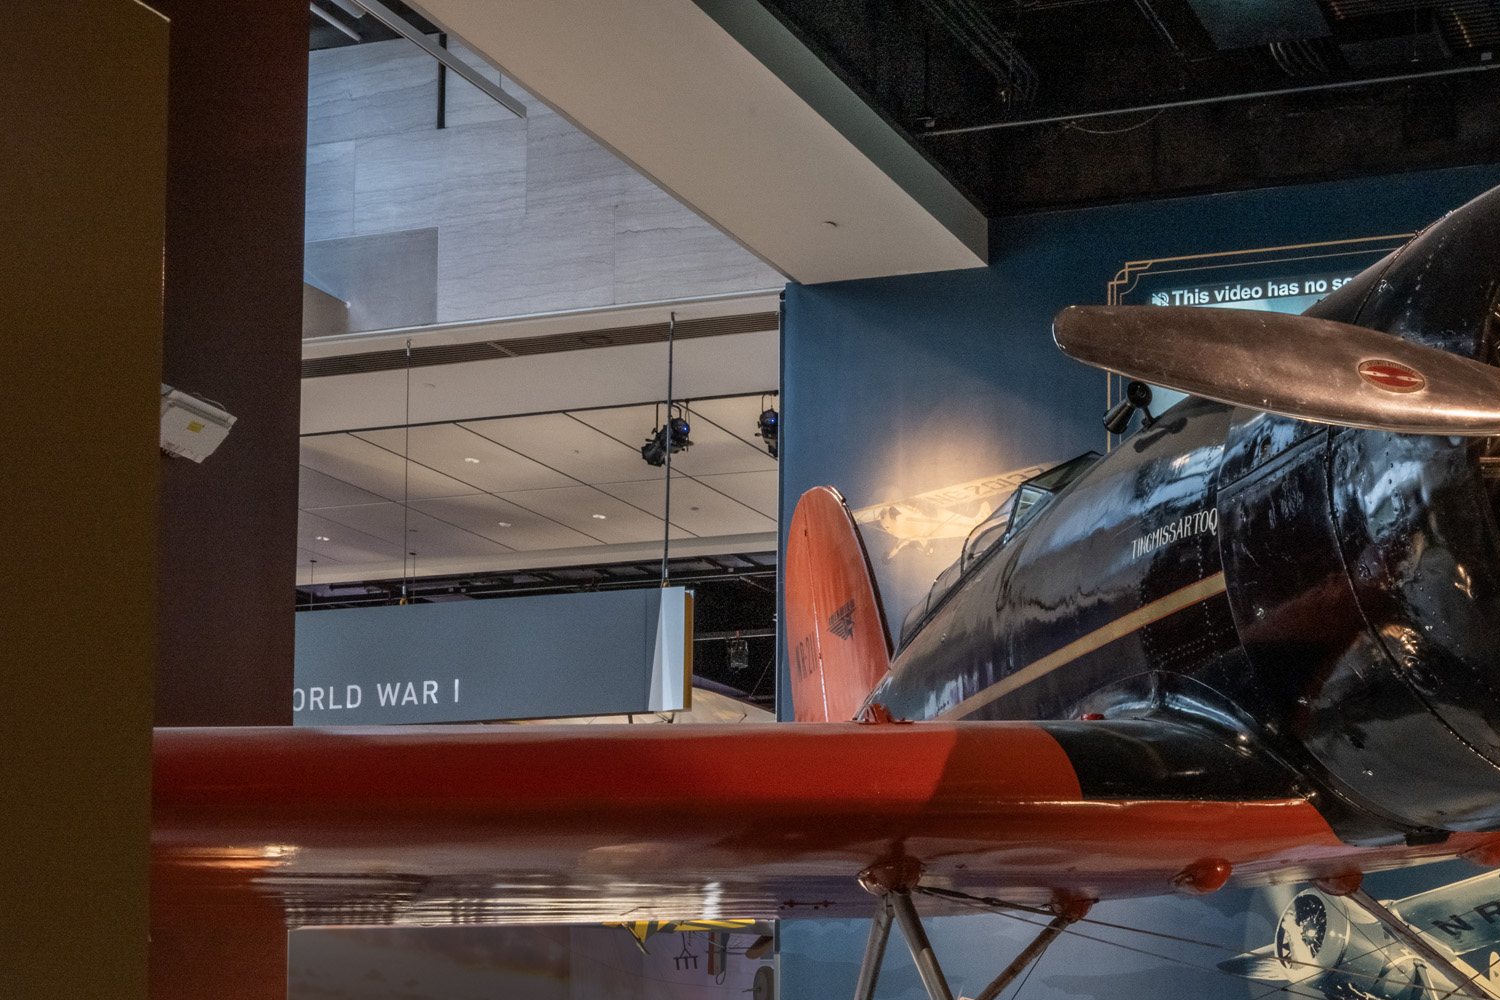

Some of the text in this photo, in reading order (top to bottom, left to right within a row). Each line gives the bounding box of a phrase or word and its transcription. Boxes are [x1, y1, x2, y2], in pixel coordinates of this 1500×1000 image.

[1172, 289, 1210, 306] This
[1214, 285, 1263, 303] video
[1267, 281, 1299, 297] has
[1304, 278, 1328, 293] no
[1131, 507, 1218, 560] TINGMISSARTOQ
[293, 678, 460, 712] ORLD WAR I
